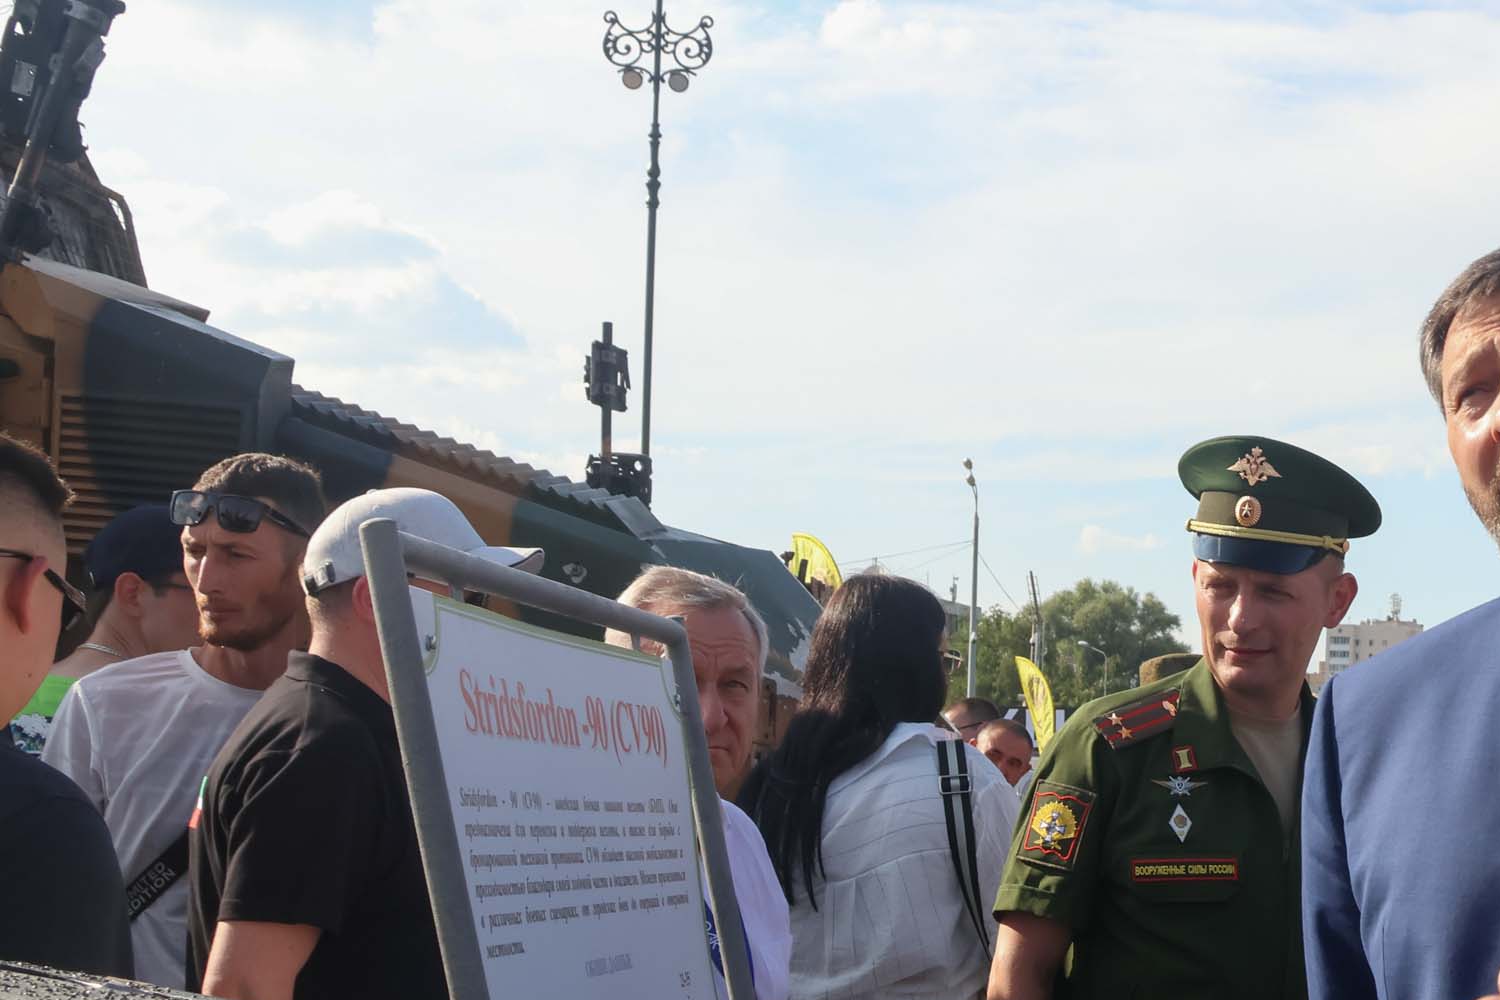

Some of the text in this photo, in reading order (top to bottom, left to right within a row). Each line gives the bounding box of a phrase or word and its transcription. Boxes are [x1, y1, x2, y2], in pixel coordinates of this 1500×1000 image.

[459, 667, 581, 748] Stridsfordon
[611, 700, 668, 768] (CV90)
[1135, 865, 1235, 876] ВООРУЖЕННЫЕ СИЛЫ РОССИИ
